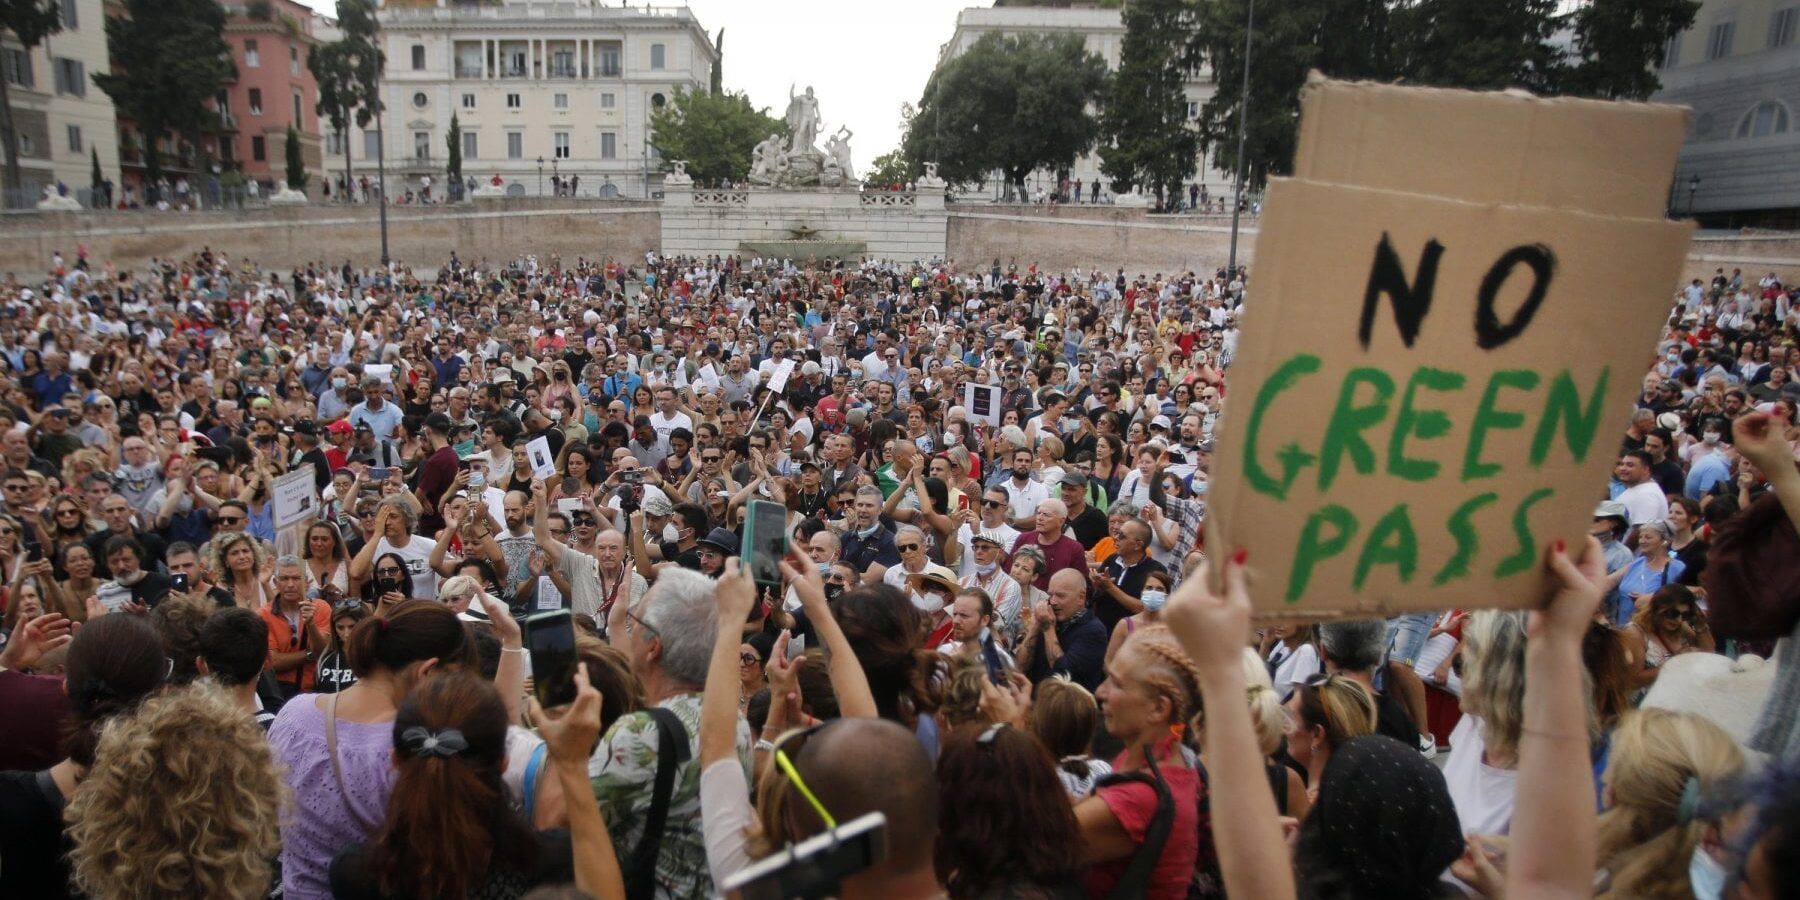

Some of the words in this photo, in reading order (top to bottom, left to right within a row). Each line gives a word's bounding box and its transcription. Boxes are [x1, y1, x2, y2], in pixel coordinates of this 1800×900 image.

[1358, 231, 1557, 351] NO
[1243, 353, 1610, 501] GREEN
[1285, 488, 1555, 603] PASS
[321, 668, 358, 683] PYR
